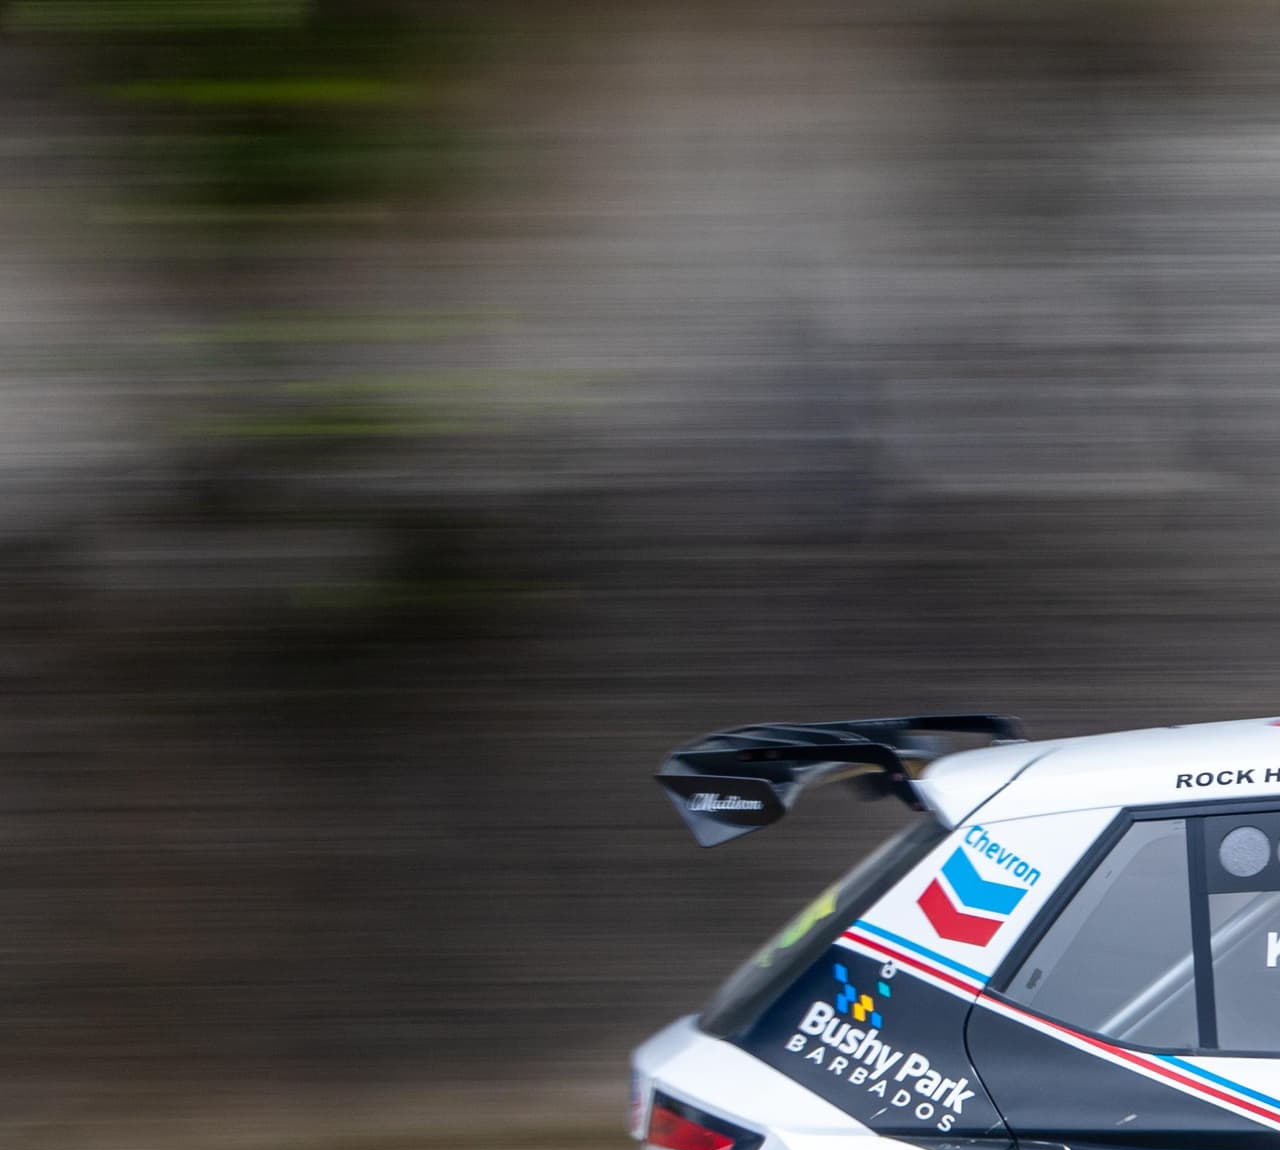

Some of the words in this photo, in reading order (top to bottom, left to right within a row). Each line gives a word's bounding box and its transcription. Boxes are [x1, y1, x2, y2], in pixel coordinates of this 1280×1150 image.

[1175, 768, 1255, 789] ROCK
[963, 824, 1042, 886] Chevron
[784, 1033, 956, 1132] BARBADOS
[797, 1000, 904, 1081] Bushy
[894, 1052, 976, 1114] Park
